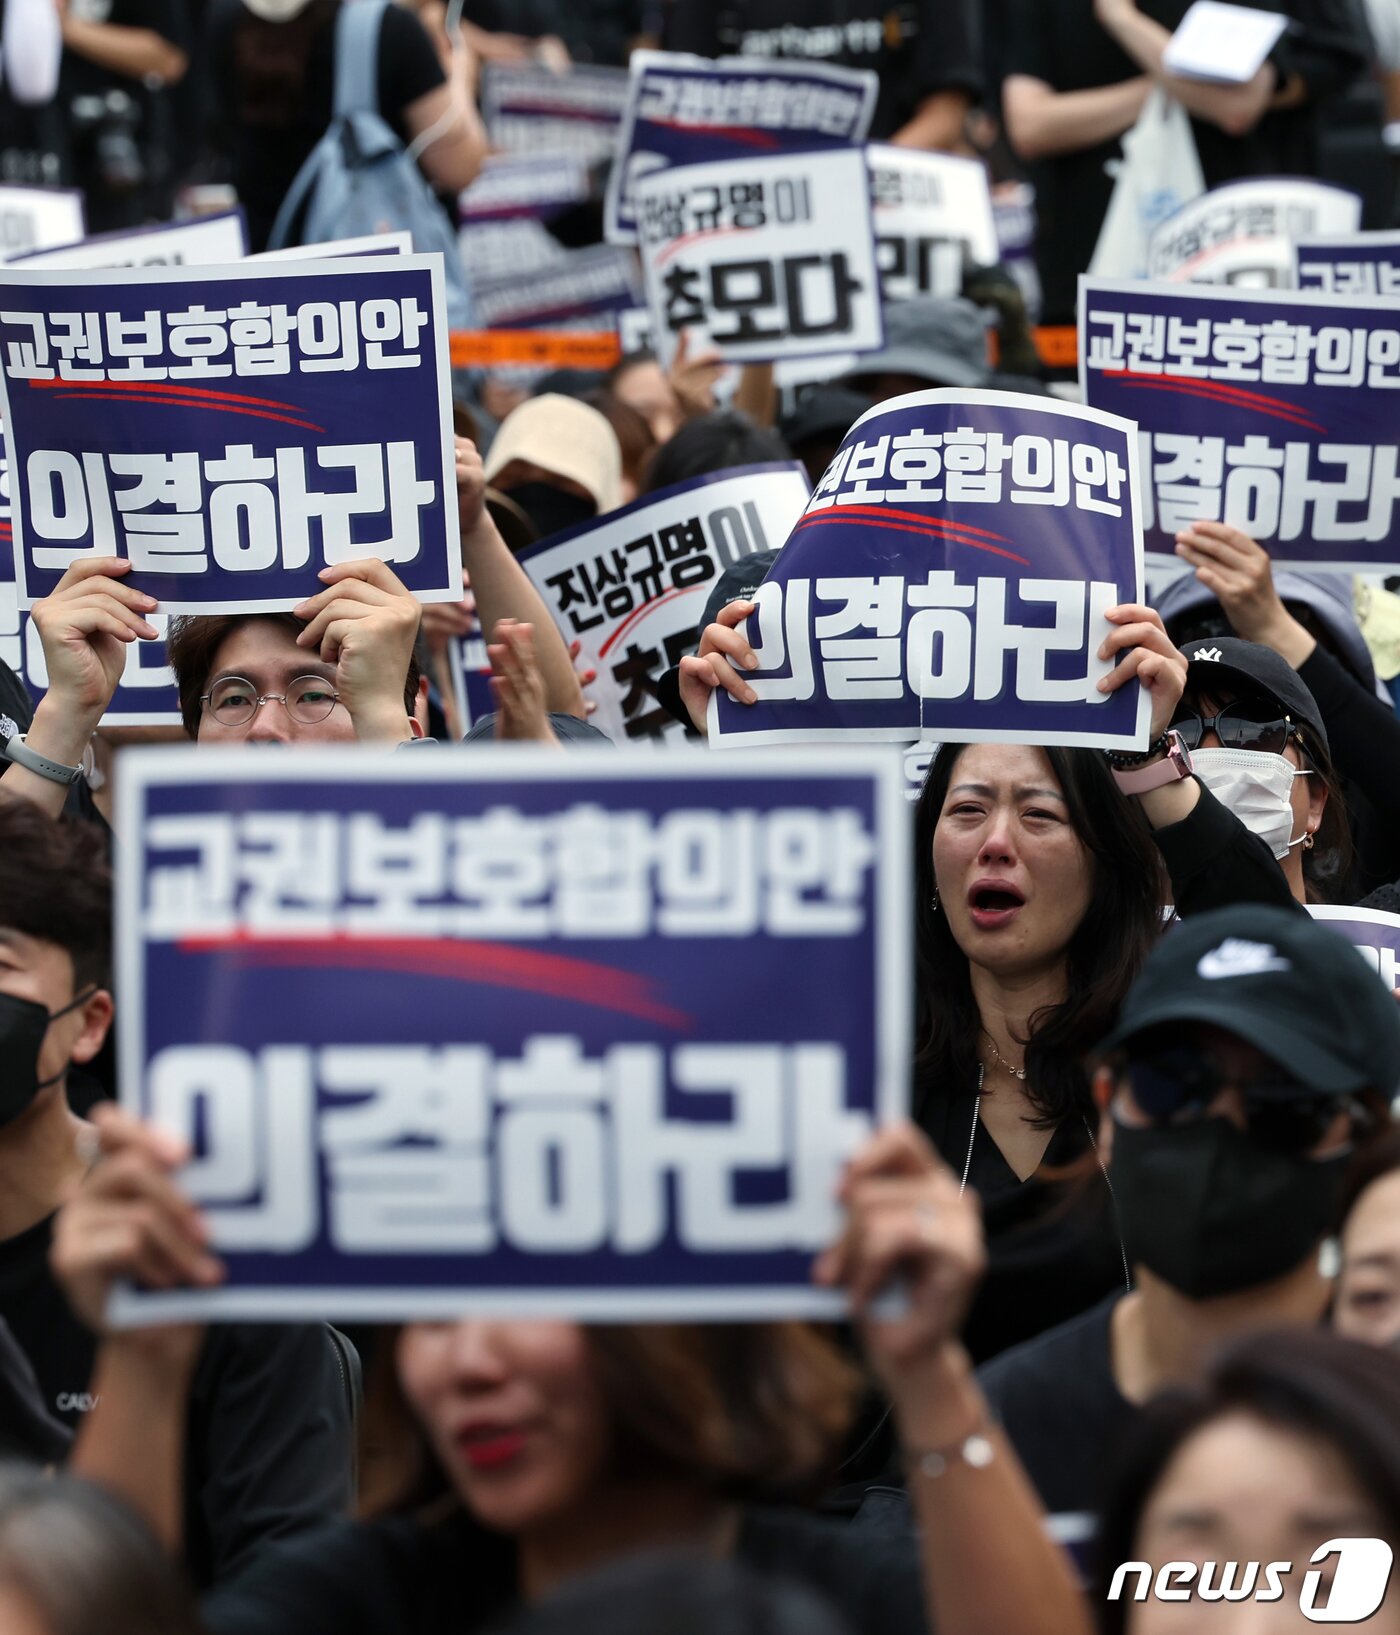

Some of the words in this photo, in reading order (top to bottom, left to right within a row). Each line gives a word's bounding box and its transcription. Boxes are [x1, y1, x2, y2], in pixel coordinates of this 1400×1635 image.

[0, 298, 428, 381] 교권보호합의안
[27, 441, 436, 573] 의결하라
[1138, 430, 1400, 542] 결하라
[545, 500, 769, 634] 진상규명이
[144, 799, 875, 941] 교권보호합의안
[146, 1035, 874, 1257] 의결하라
